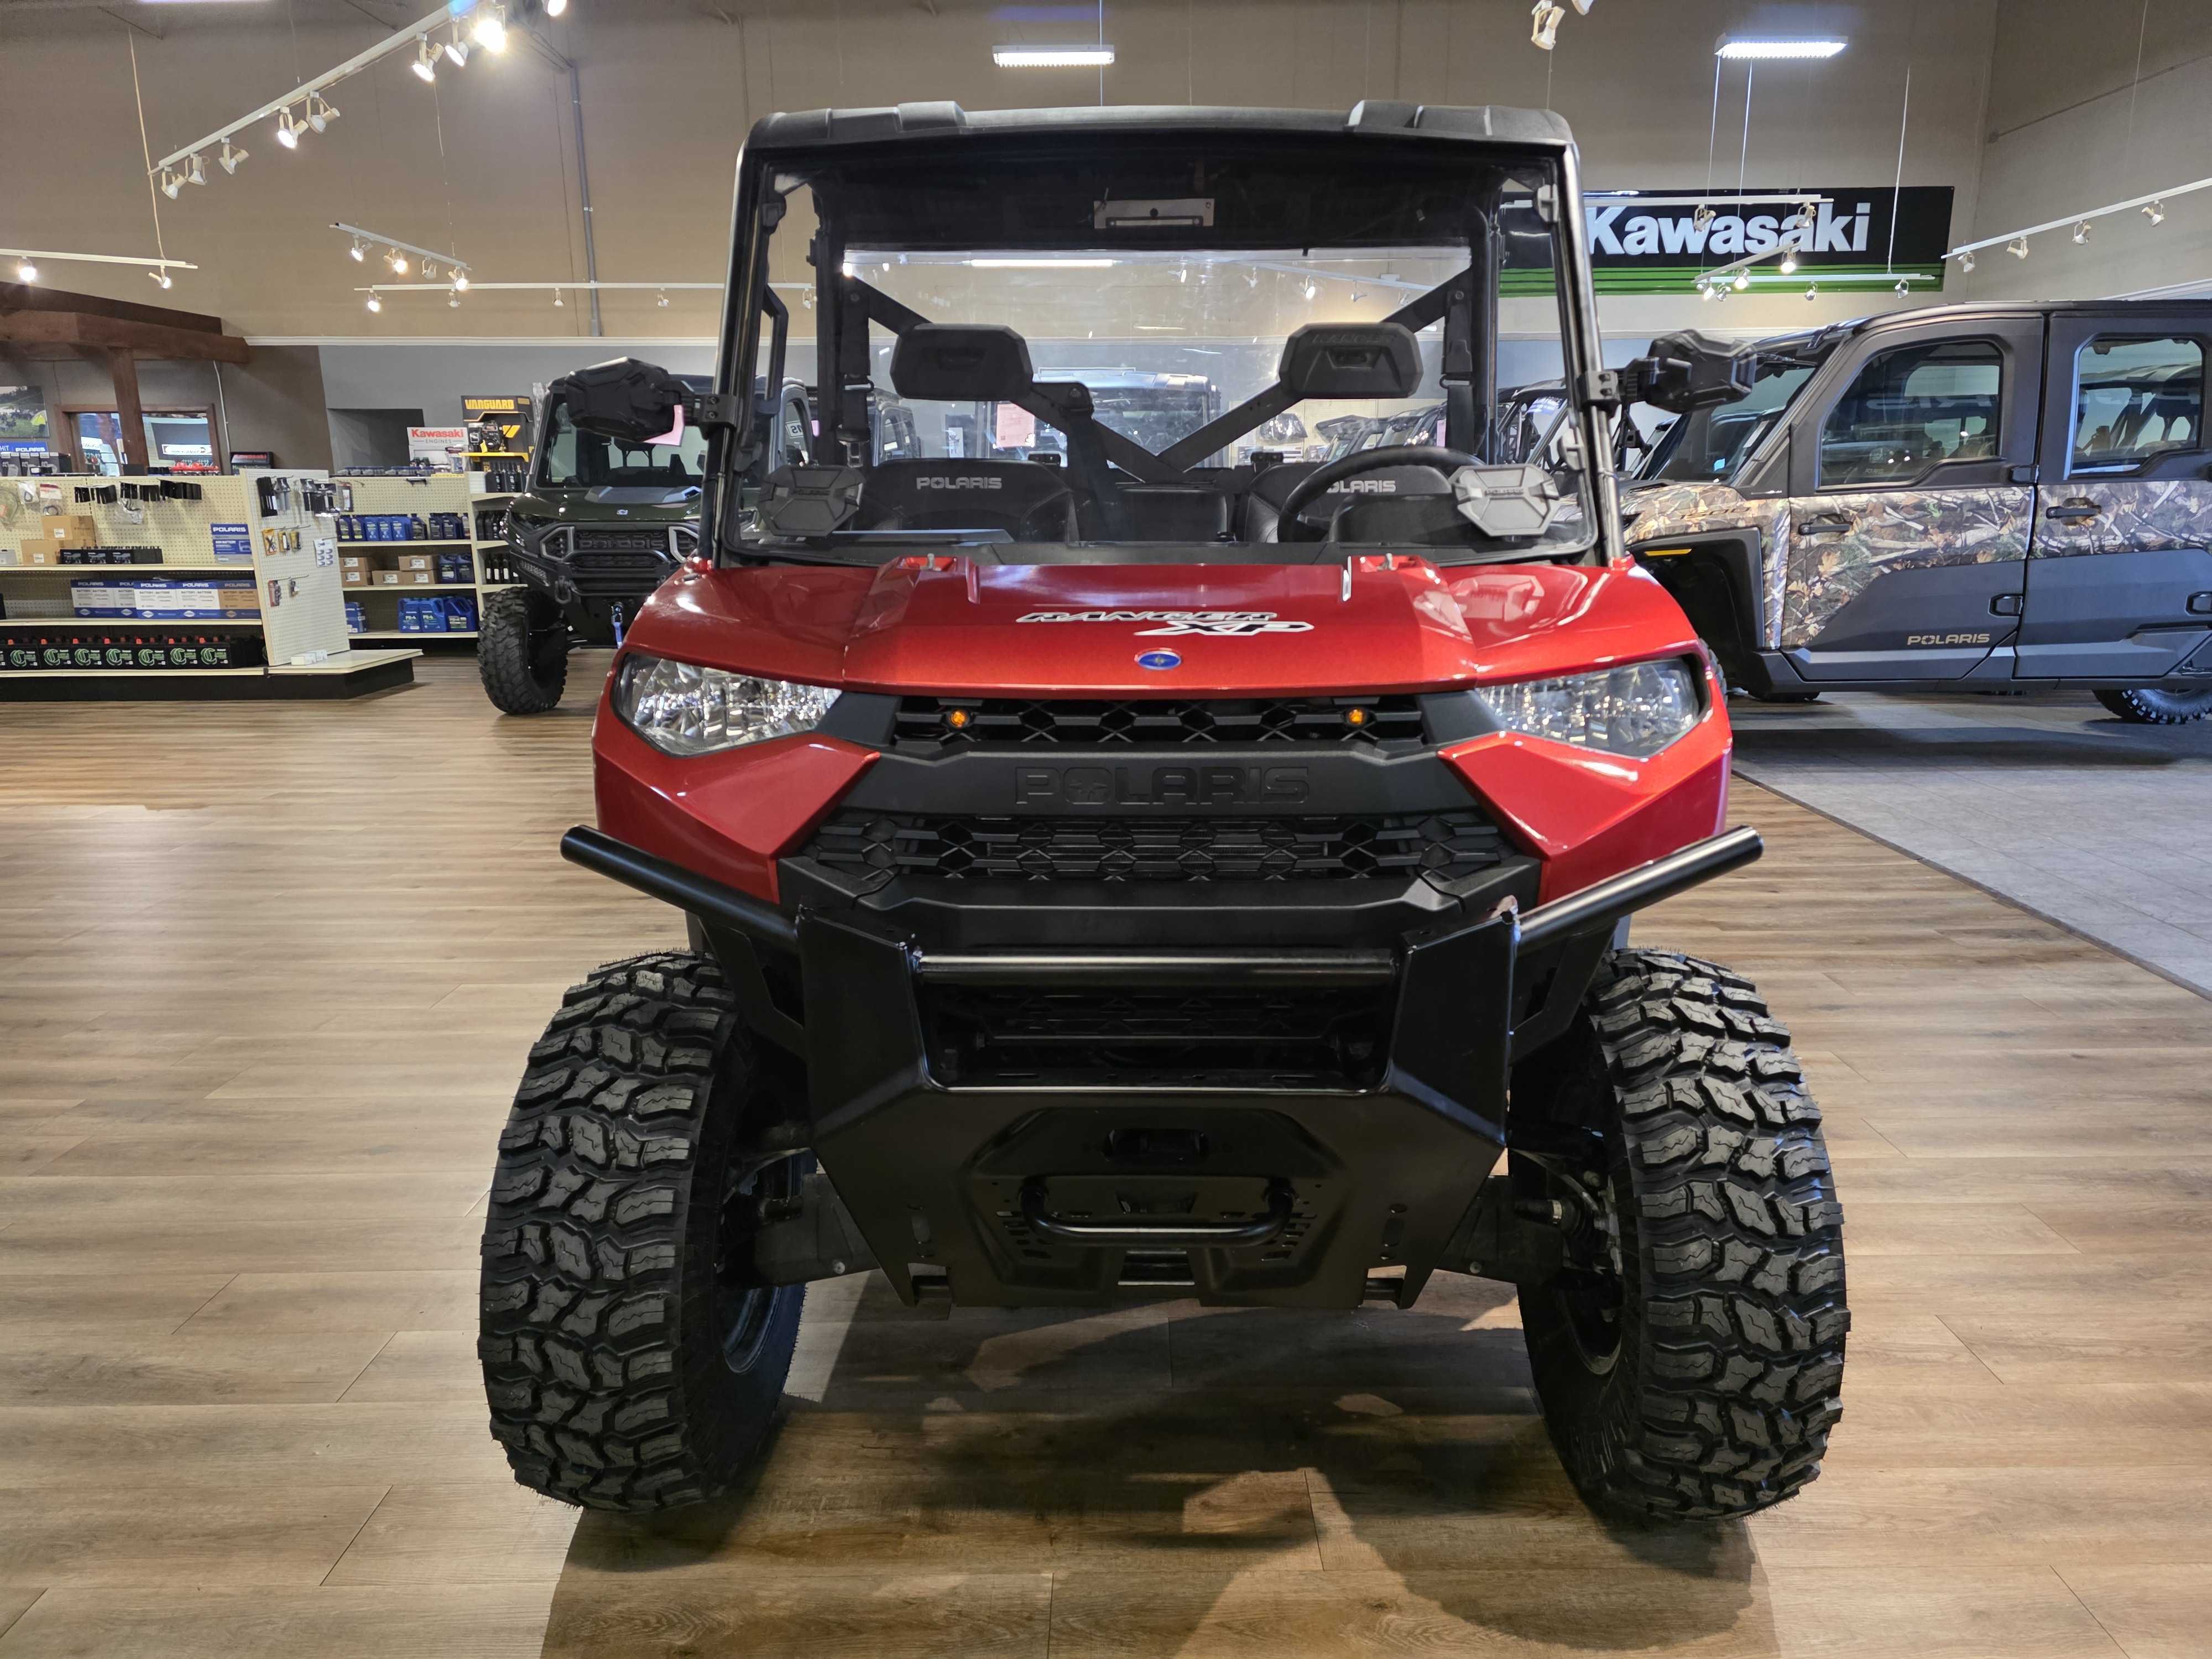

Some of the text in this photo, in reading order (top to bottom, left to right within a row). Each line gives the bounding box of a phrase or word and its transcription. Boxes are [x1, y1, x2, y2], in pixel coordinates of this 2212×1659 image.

[1585, 202, 1871, 254] Kawasaki
[465, 399, 514, 409] VANGUARD
[411, 429, 464, 437] Kawasaki
[916, 477, 1003, 490] POLARIS
[1326, 480, 1396, 493] OLARIS
[1680, 507, 1751, 520] 1500
[1016, 611, 1277, 622] RANGER
[1134, 620, 1314, 636] XP
[1907, 633, 1991, 645] POLARIS
[1015, 766, 1310, 805] POLARIS
